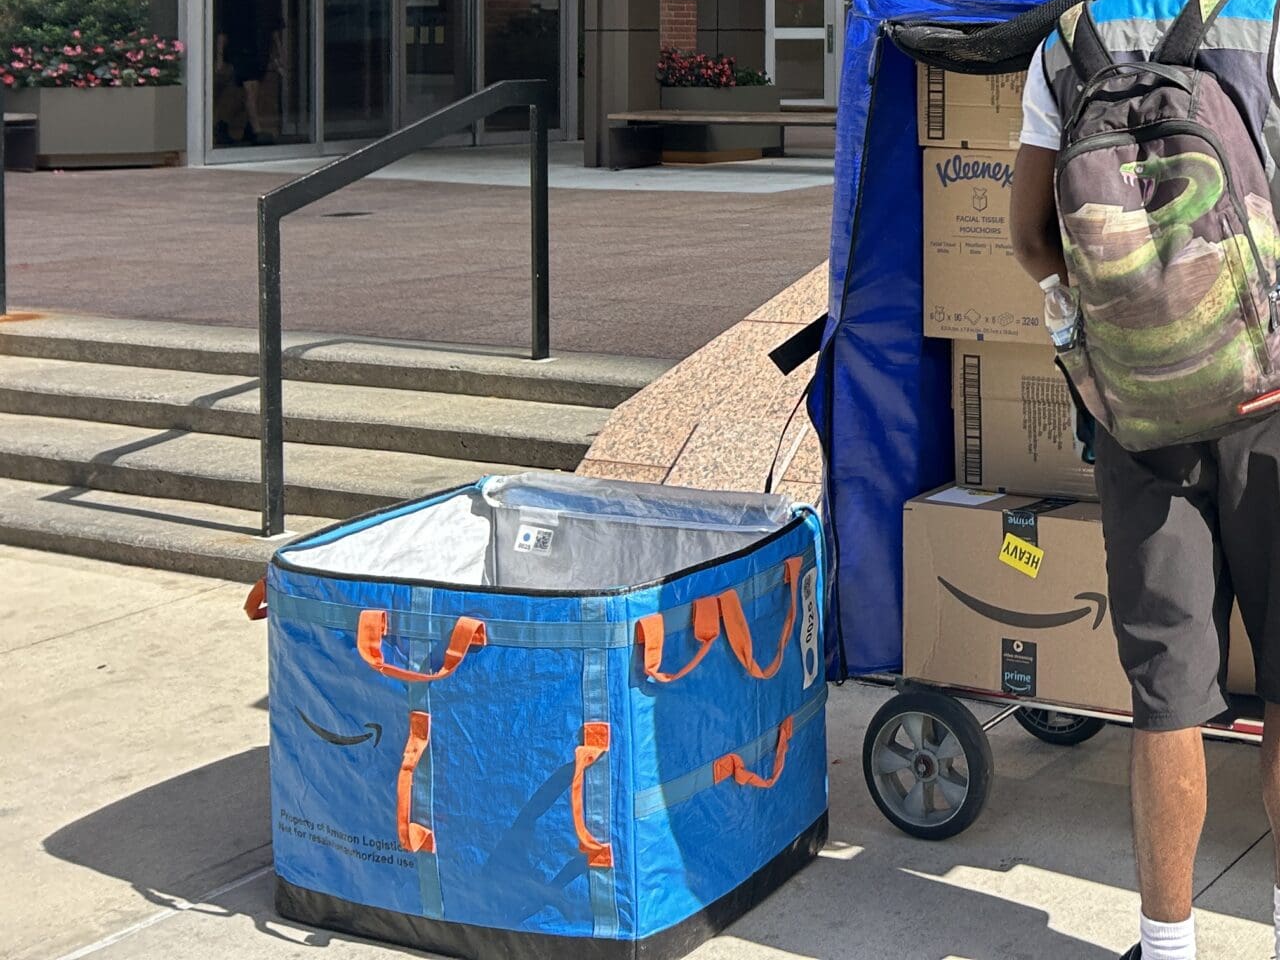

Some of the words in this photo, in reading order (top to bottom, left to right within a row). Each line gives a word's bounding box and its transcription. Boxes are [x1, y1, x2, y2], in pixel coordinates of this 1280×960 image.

[936, 154, 1015, 188] Kleenex
[955, 215, 979, 223] FACIAL
[981, 216, 1005, 224] TISSUE
[1021, 317, 1039, 326] 3240
[1007, 516, 1035, 527] prime
[1003, 541, 1041, 570] HEAVY
[1004, 671, 1031, 683] prime
[280, 809, 315, 830] Property
[326, 825, 360, 844] Amazon
[294, 826, 306, 838] for
[397, 858, 414, 868] use
